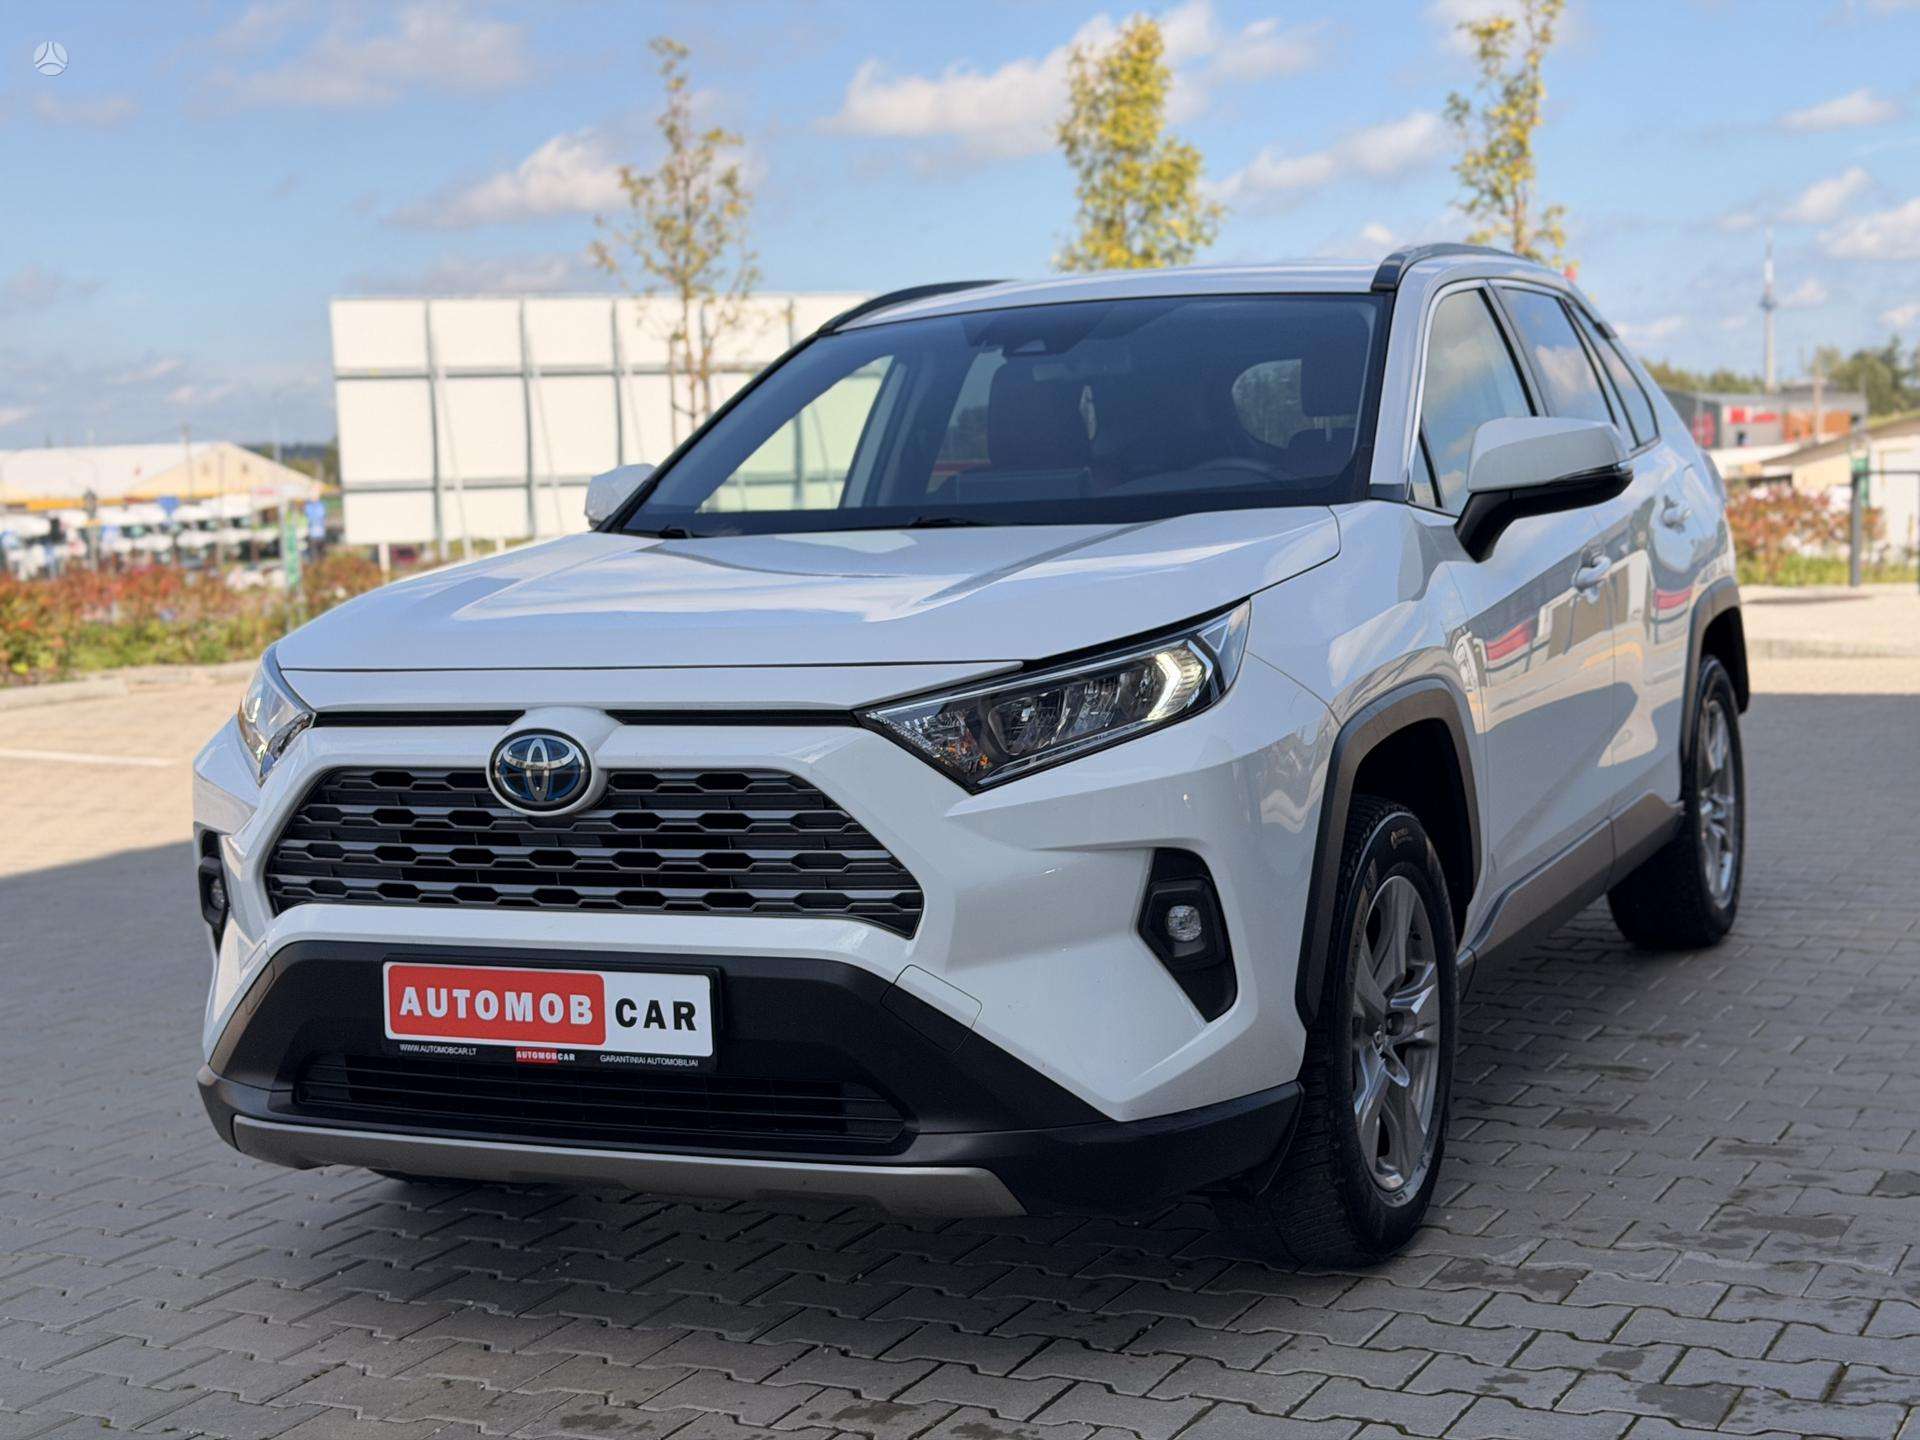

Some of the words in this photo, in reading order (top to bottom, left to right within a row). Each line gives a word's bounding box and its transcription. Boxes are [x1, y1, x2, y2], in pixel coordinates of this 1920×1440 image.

[400, 987, 593, 1025] AUTOMOB
[615, 998, 696, 1031] CAR
[400, 1043, 477, 1056] WWW.AUTOMOBCAR.LT
